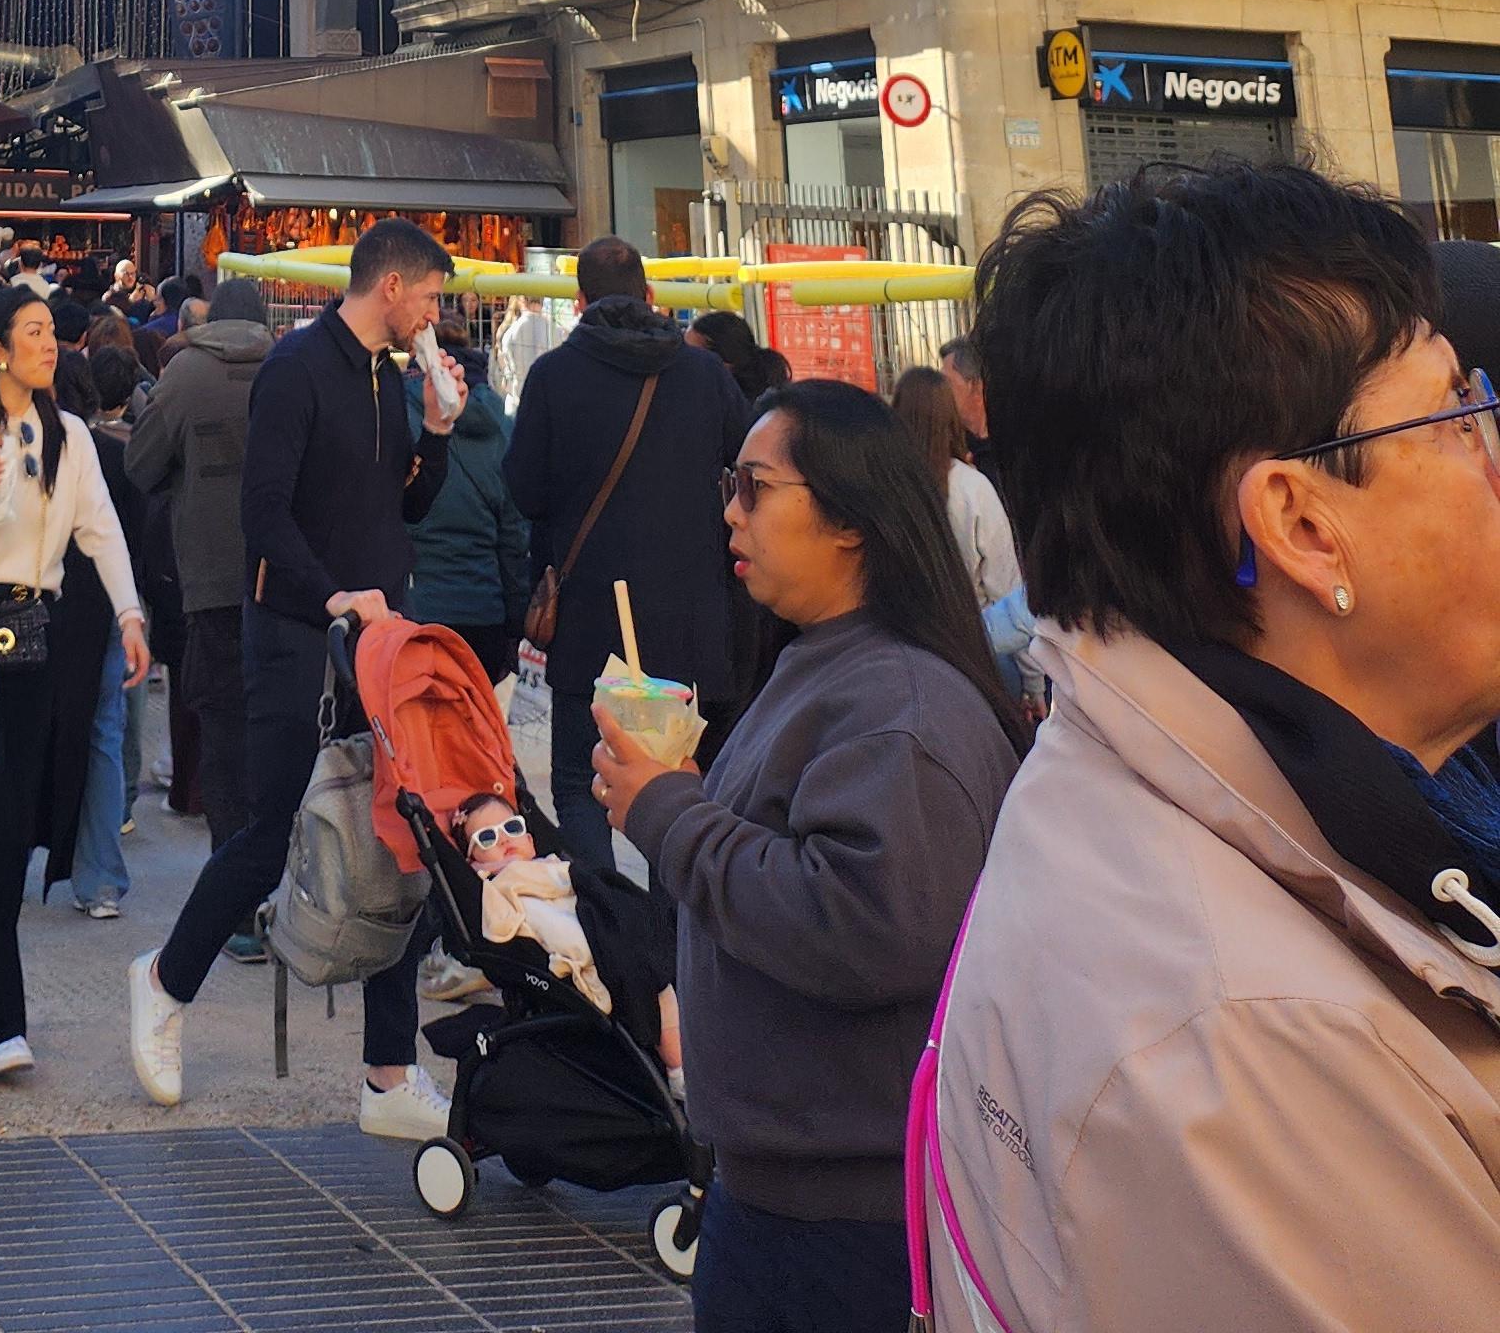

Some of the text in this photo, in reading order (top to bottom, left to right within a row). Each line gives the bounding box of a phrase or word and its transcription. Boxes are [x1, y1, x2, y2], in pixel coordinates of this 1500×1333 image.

[815, 71, 879, 110] Negocis
[1163, 70, 1282, 110] Negocis
[978, 1083, 1023, 1145] REGATTA
